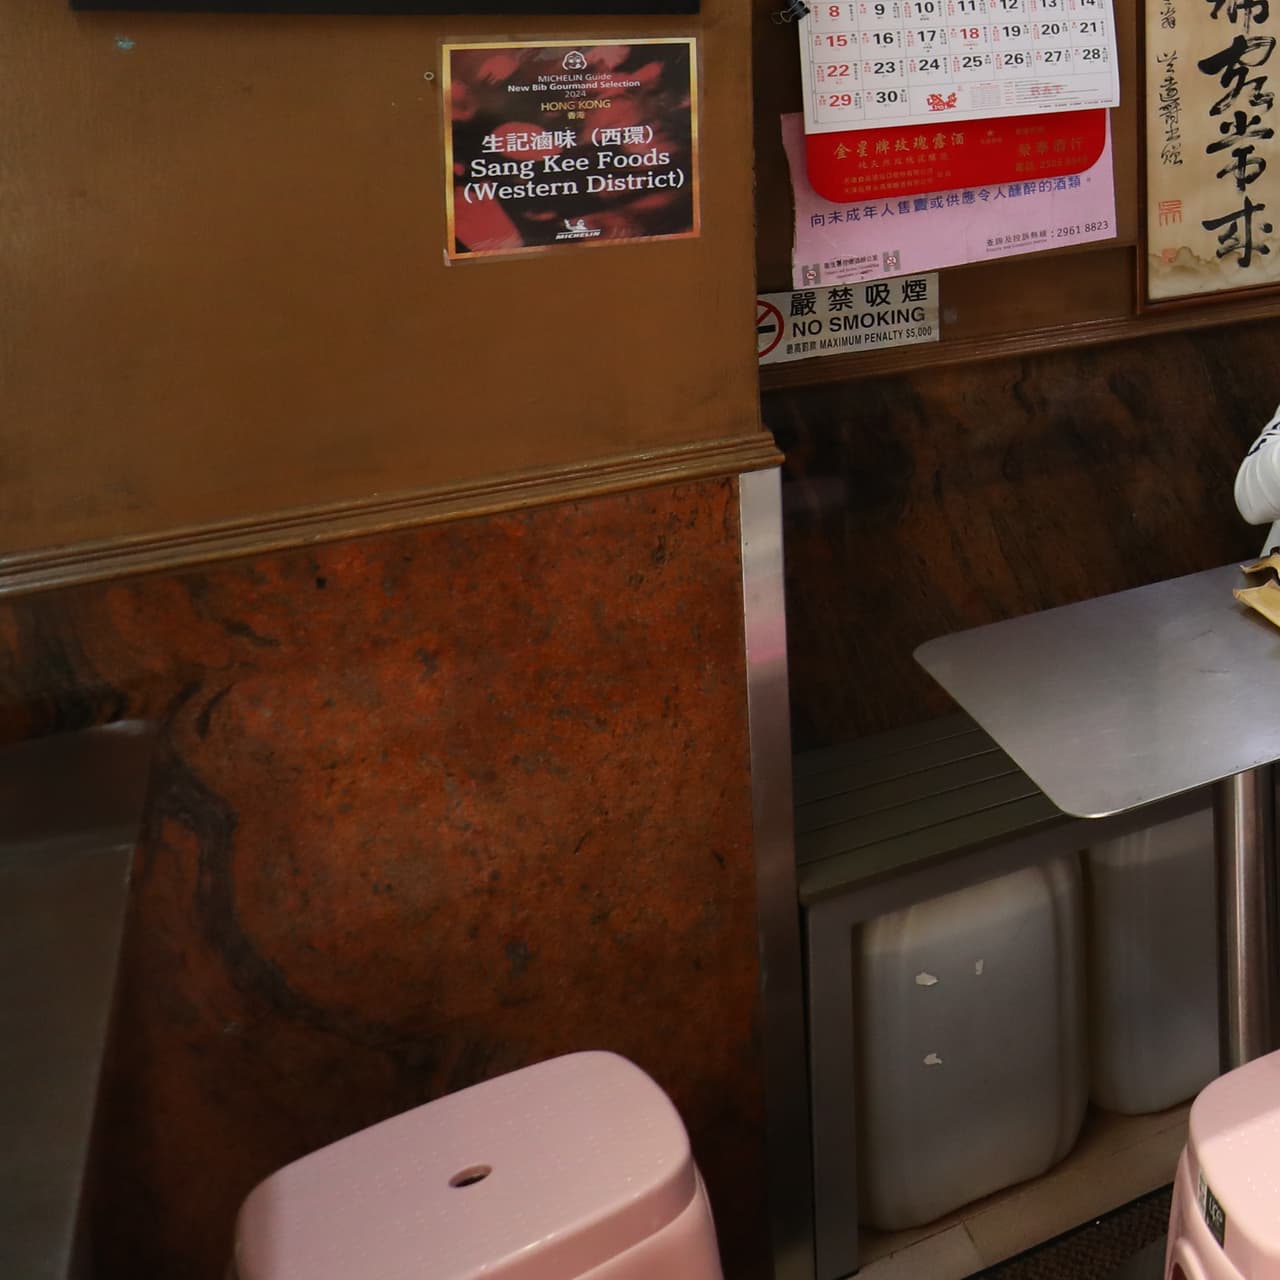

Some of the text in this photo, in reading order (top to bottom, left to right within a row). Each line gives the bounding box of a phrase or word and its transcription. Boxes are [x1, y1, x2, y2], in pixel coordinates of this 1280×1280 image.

[829, 6, 839, 17] 8
[875, 4, 884, 15] 9
[915, 2, 934, 13] 10
[958, 0, 975, 11] 11
[1000, 0, 1018, 9] 12
[826, 22, 1096, 47] 15 16 17 18 19 20 21
[828, 49, 1100, 77] 22 23 24 25 26 27 28
[508, 80, 640, 92] New Bib Gourmand Selection
[538, 73, 612, 82] MICHELIN Guide
[564, 90, 587, 98] 2024
[830, 91, 897, 107] 29 30
[541, 99, 611, 111] HONG KONG
[471, 149, 670, 179] Sang Kee Foods
[463, 169, 684, 203] (Western District)
[1056, 220, 1109, 238] 2961 8823
[790, 277, 927, 317] 嚴禁吸煙
[792, 306, 925, 338] NO SMOKING
[820, 334, 861, 350] MAXIMUM
[864, 329, 904, 344] PENALTY
[906, 325, 932, 339] $5,000
